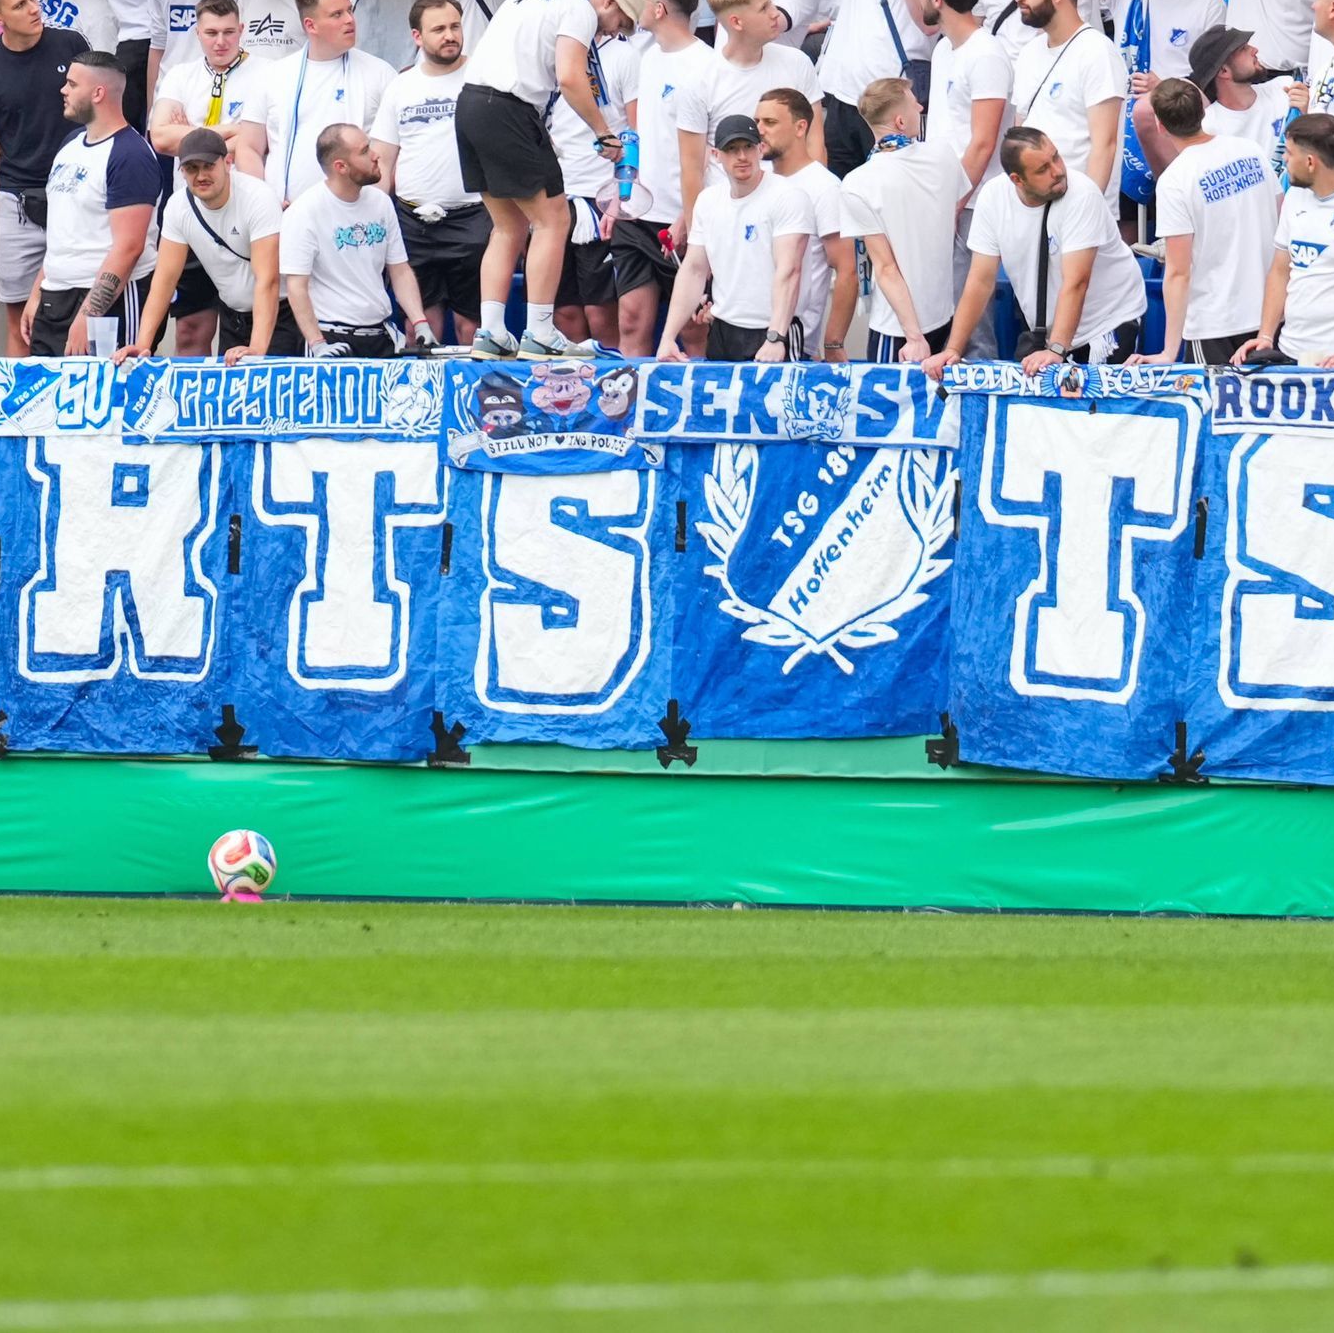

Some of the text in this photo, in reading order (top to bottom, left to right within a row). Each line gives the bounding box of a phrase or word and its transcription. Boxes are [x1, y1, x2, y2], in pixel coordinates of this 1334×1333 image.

[256, 37, 294, 45] INDUSTRIES
[414, 102, 456, 115] ROOKIEZ
[1198, 156, 1260, 191] SÜDKURVE
[1290, 245, 1317, 269] SAP
[1098, 363, 1172, 397] BOYZ
[13, 391, 30, 409] TSG
[132, 394, 147, 414] TSG
[173, 363, 385, 431] CRESCENDO
[642, 364, 783, 435] SEK
[488, 439, 525, 455] STILL
[527, 434, 549, 451] NOT
[771, 490, 820, 548] TSG
[787, 463, 892, 616] Hoffenheim
